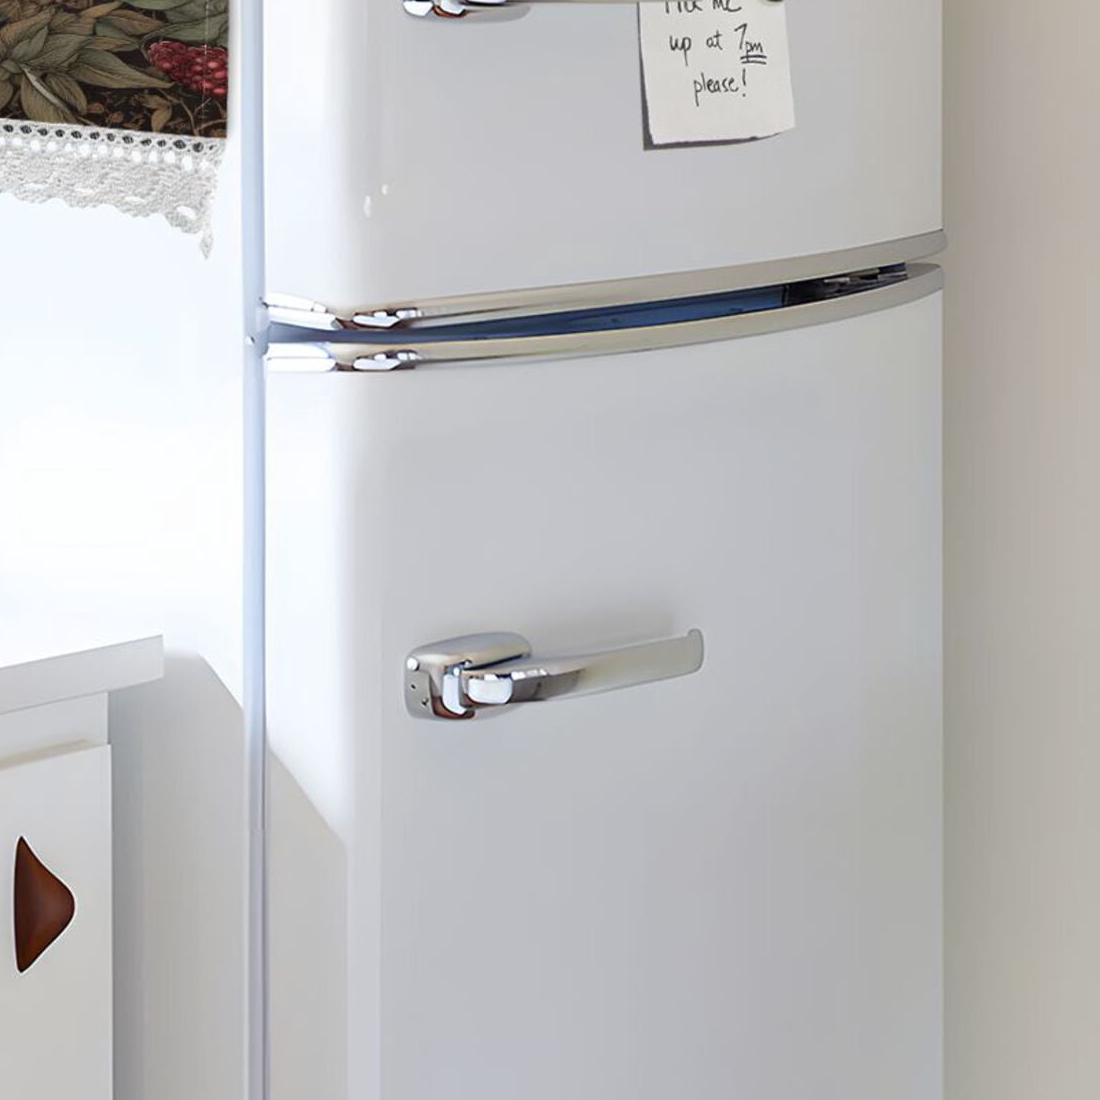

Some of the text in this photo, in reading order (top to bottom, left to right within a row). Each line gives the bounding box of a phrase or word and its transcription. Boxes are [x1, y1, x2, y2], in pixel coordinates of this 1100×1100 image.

[669, 35, 692, 66] up
[706, 30, 723, 50] at
[693, 68, 746, 107] please!
